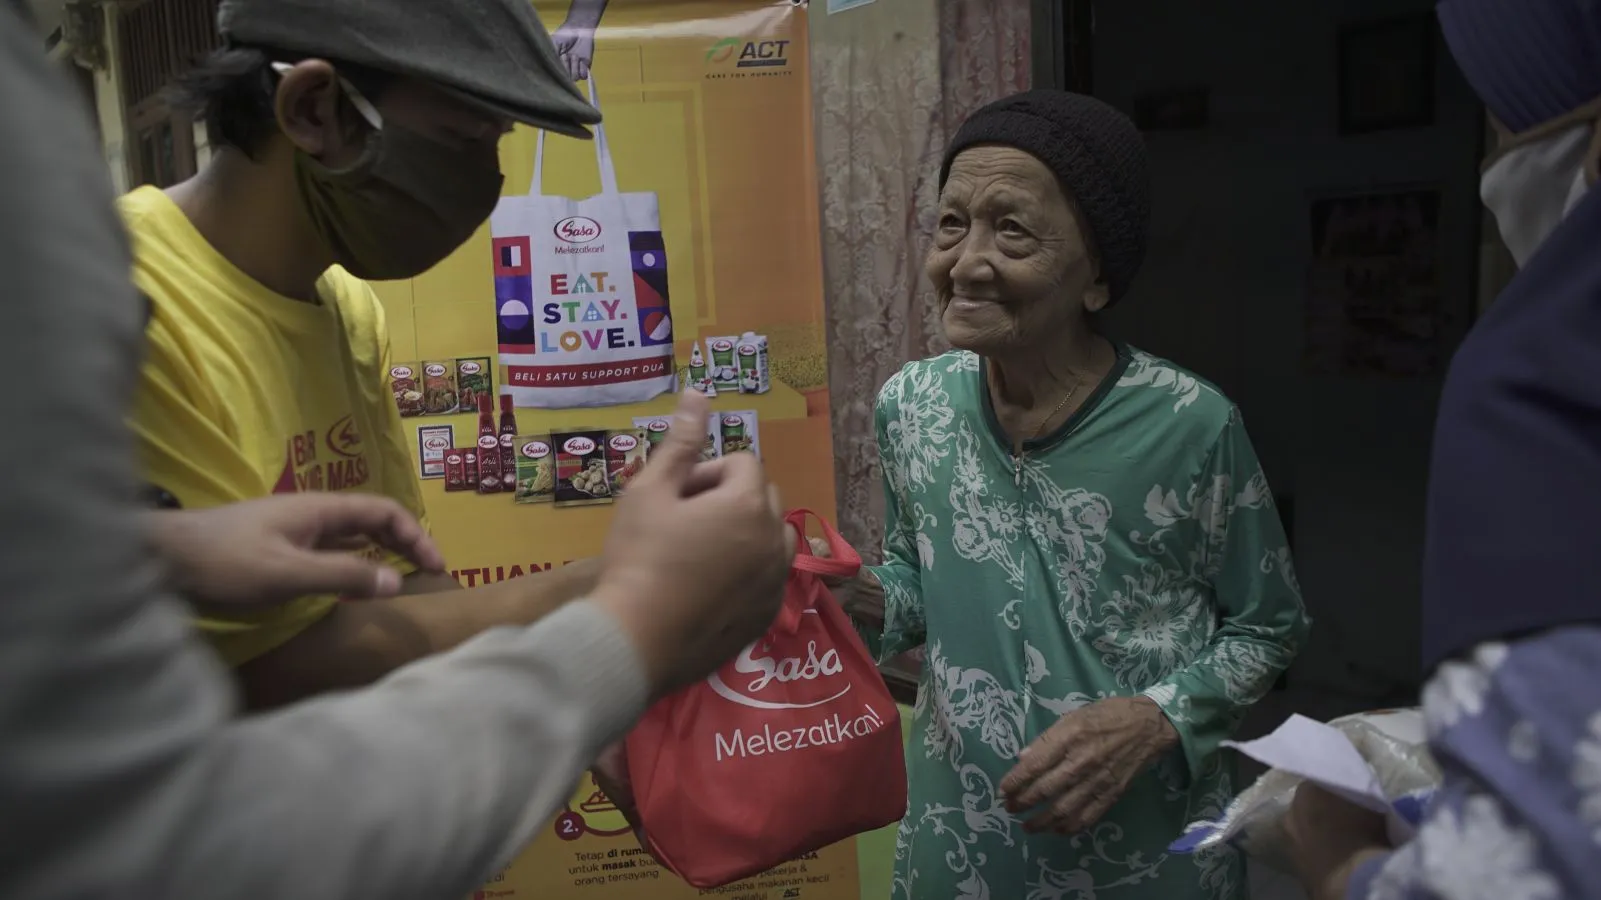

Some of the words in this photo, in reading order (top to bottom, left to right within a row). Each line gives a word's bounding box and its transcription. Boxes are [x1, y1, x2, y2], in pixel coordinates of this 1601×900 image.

[739, 40, 790, 59] ACT
[562, 221, 594, 238] Sasa
[554, 244, 605, 255] Melezatkan!
[551, 271, 616, 295] EAT.
[543, 299, 628, 324] STAY.
[540, 327, 635, 352] LOVE.
[514, 372, 540, 382] BELI
[545, 372, 577, 381] SATU
[582, 366, 638, 380] SUPPORT
[642, 362, 665, 373] DUA
[526, 444, 548, 457] Sasa
[568, 439, 592, 452] Sasa
[613, 438, 635, 449] Sasa
[735, 640, 843, 692] Sasa
[563, 819, 579, 833] 2.
[574, 852, 604, 861] Tetap
[607, 848, 618, 858] di
[568, 864, 599, 875] untuk
[602, 859, 637, 870] masak
[799, 862, 807, 872] &
[574, 876, 605, 887] orang
[608, 869, 660, 882] tersayang
[757, 877, 804, 889] makanan
[806, 873, 830, 884] kecil
[783, 887, 801, 897] ACT
